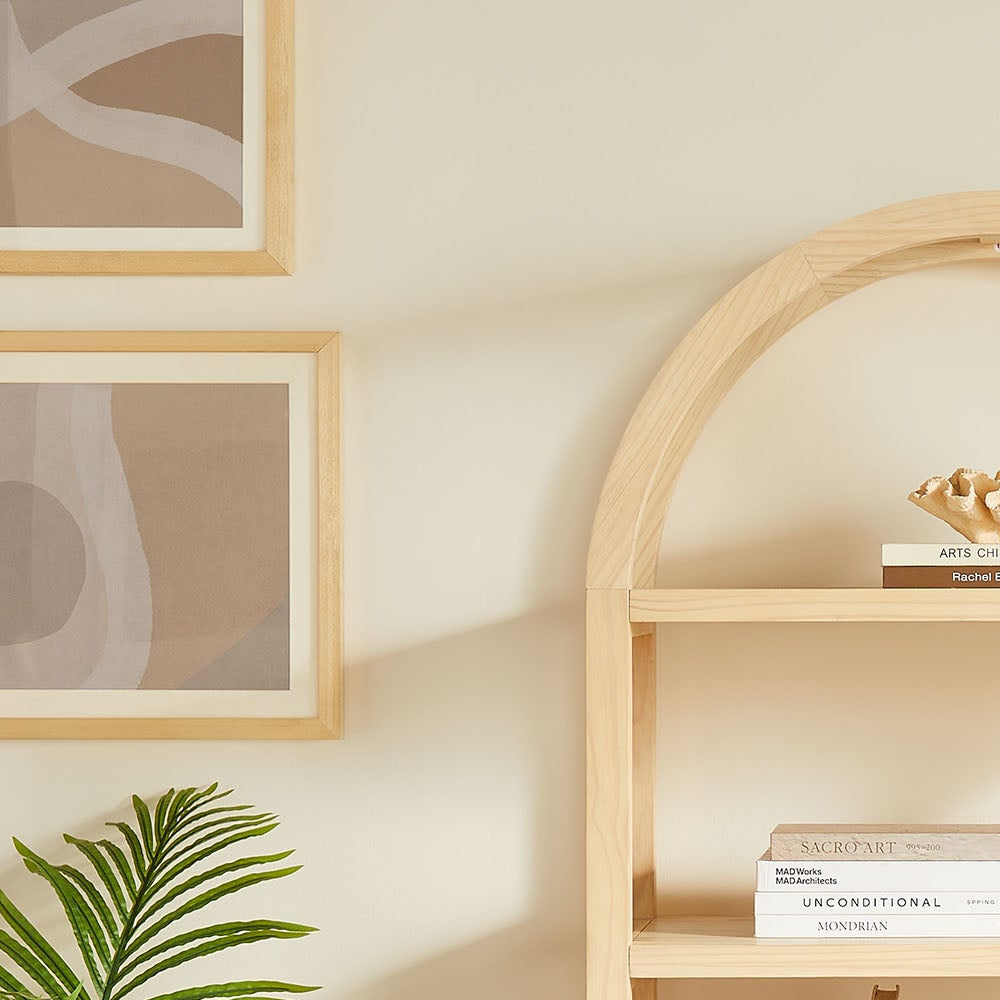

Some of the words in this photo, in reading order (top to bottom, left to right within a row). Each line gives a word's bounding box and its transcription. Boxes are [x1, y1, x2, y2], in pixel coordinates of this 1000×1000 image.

[939, 547, 972, 559] ARTS
[977, 547, 999, 559] CHI
[952, 571, 992, 583] Rachel
[801, 841, 858, 854] SACRO
[863, 841, 897, 854] ART
[802, 897, 941, 908] UNCONDITIONAL
[817, 920, 889, 932] MONDRIAN
